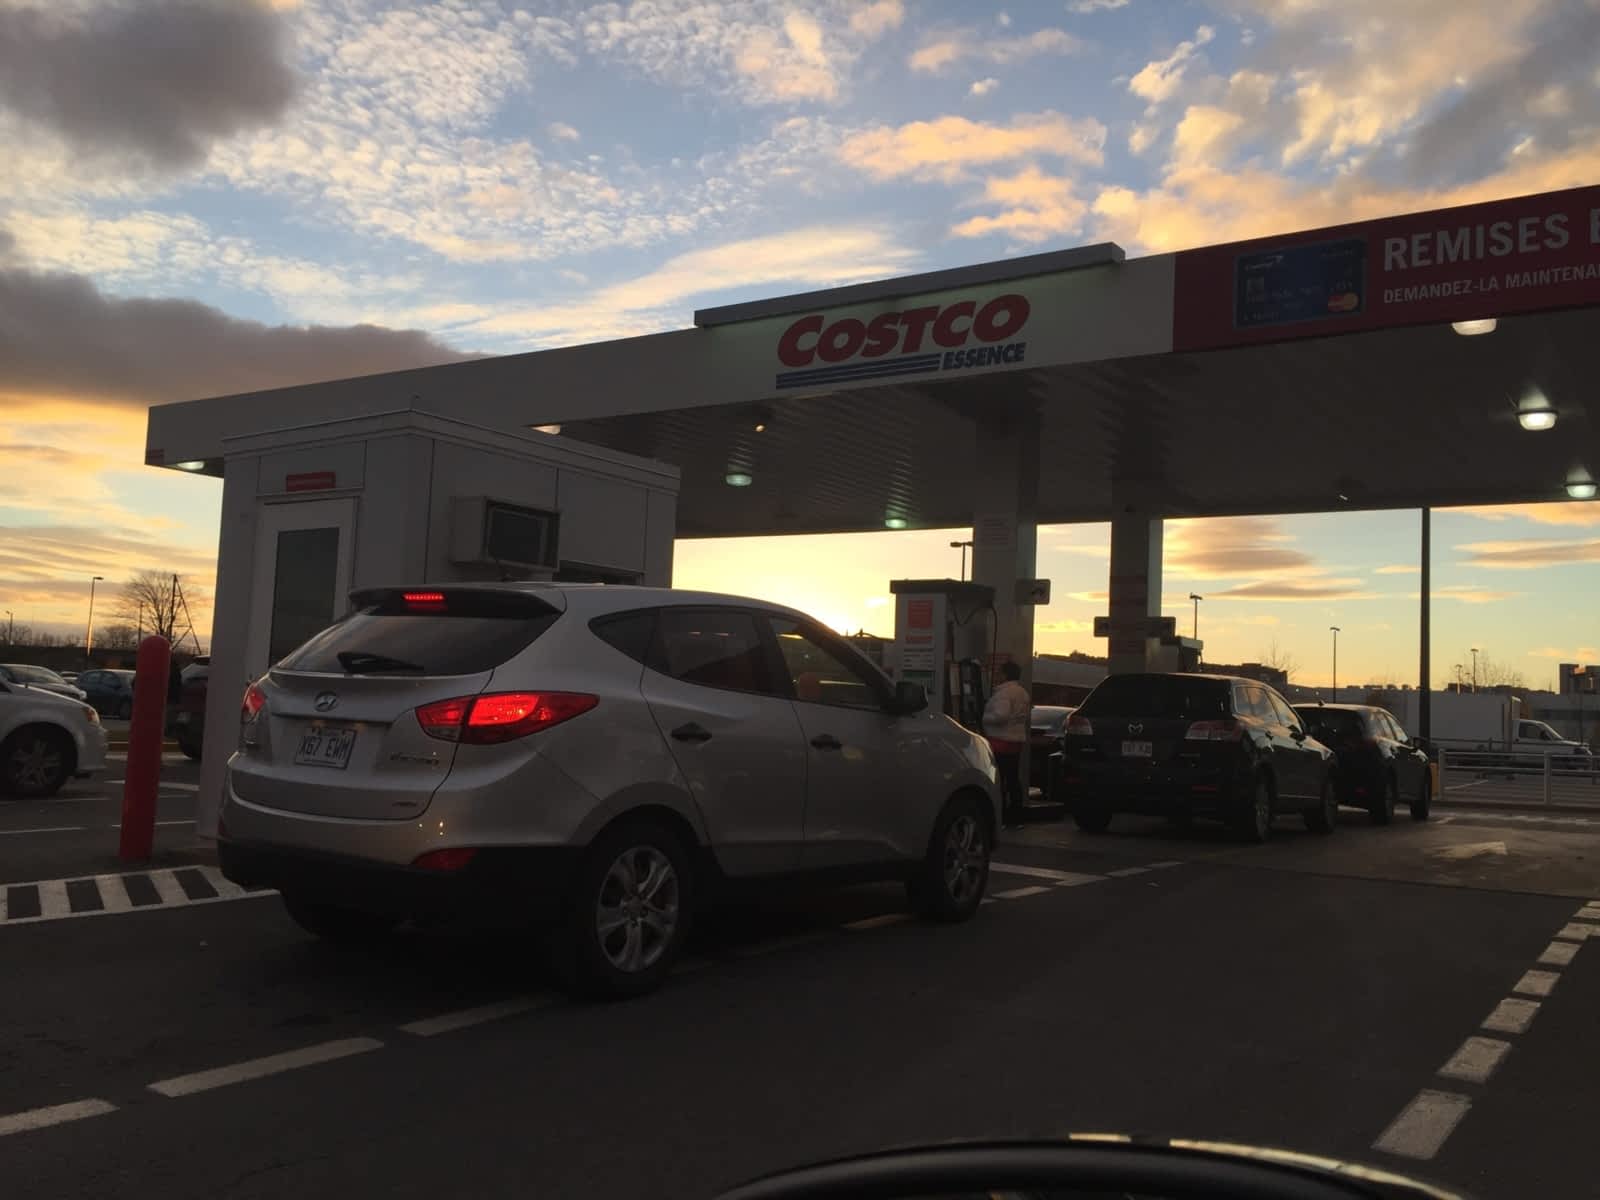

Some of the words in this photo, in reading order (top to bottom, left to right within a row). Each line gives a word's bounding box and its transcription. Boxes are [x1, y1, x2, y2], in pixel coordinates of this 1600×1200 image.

[1384, 212, 1569, 272] REMISES
[1384, 275, 1499, 304] DEMANDEZ-LA
[1505, 263, 1600, 288] MAINTENA
[777, 294, 1031, 368] COSTCO
[942, 342, 1026, 371] ESSENCE
